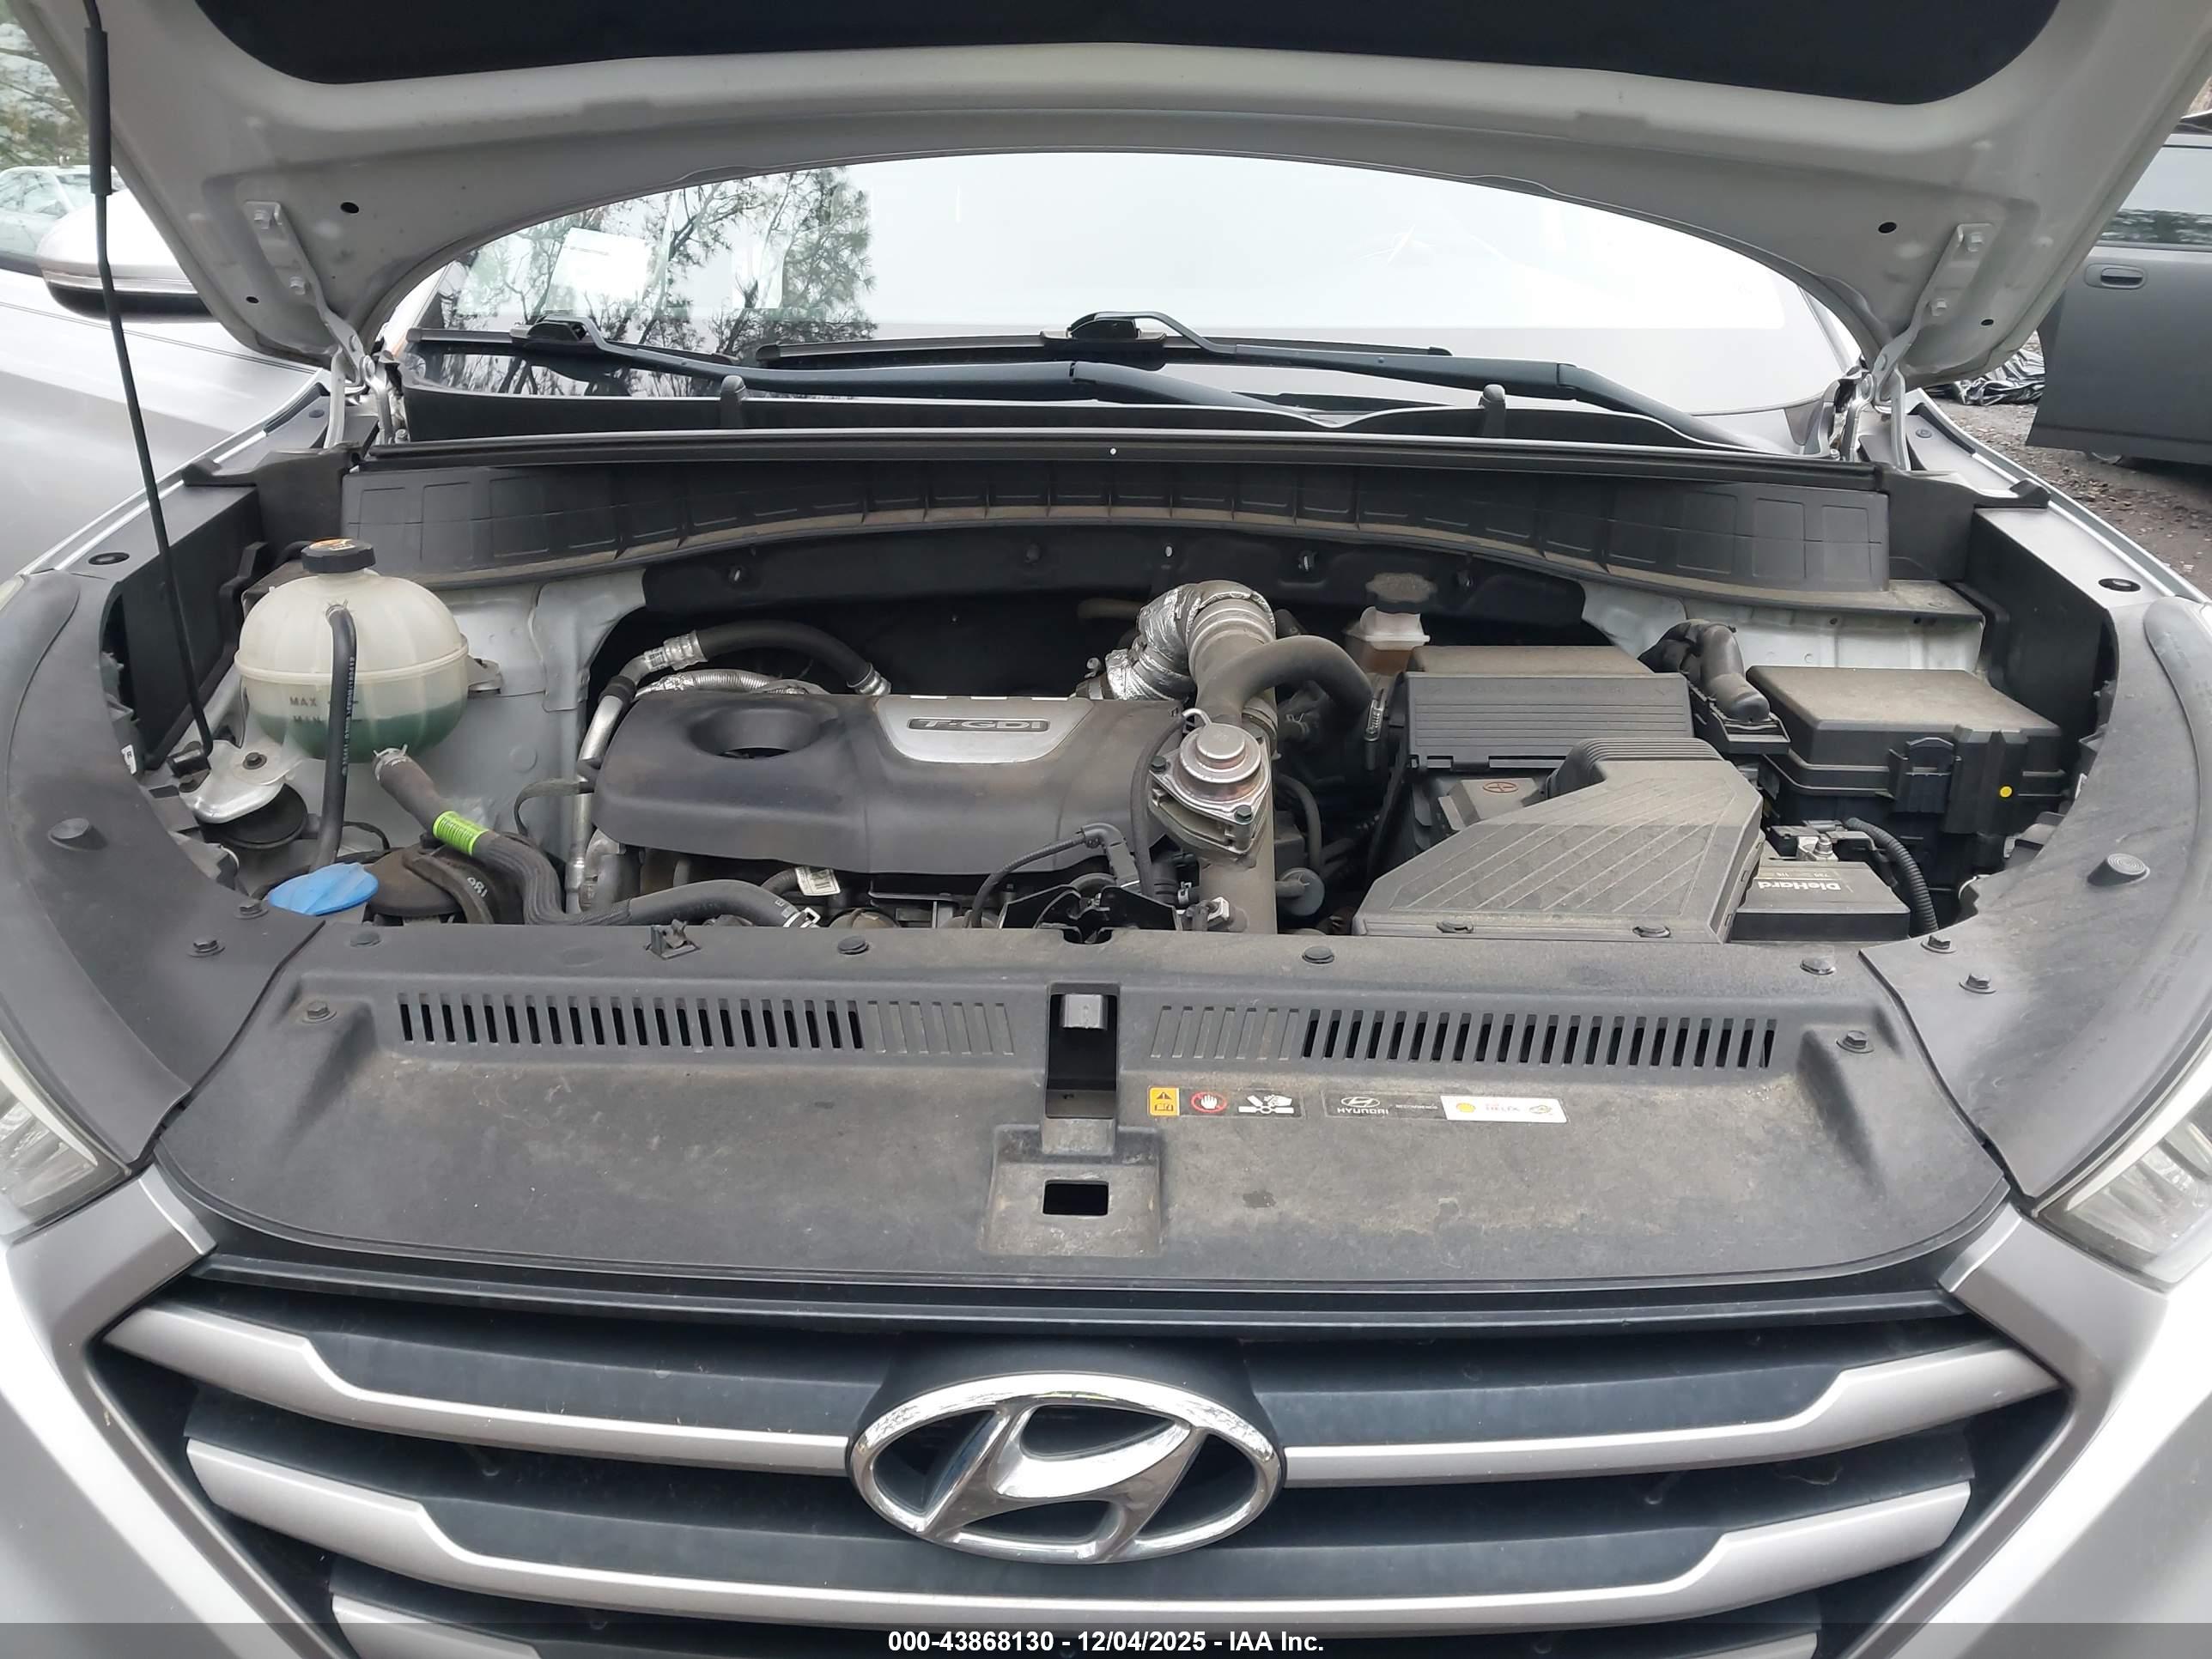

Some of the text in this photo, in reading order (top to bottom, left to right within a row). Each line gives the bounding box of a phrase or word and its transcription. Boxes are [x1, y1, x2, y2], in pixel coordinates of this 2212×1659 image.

[289, 692, 317, 706] MAX
[918, 720, 1041, 729] T-GDI
[1758, 881, 1841, 890] DieHard
